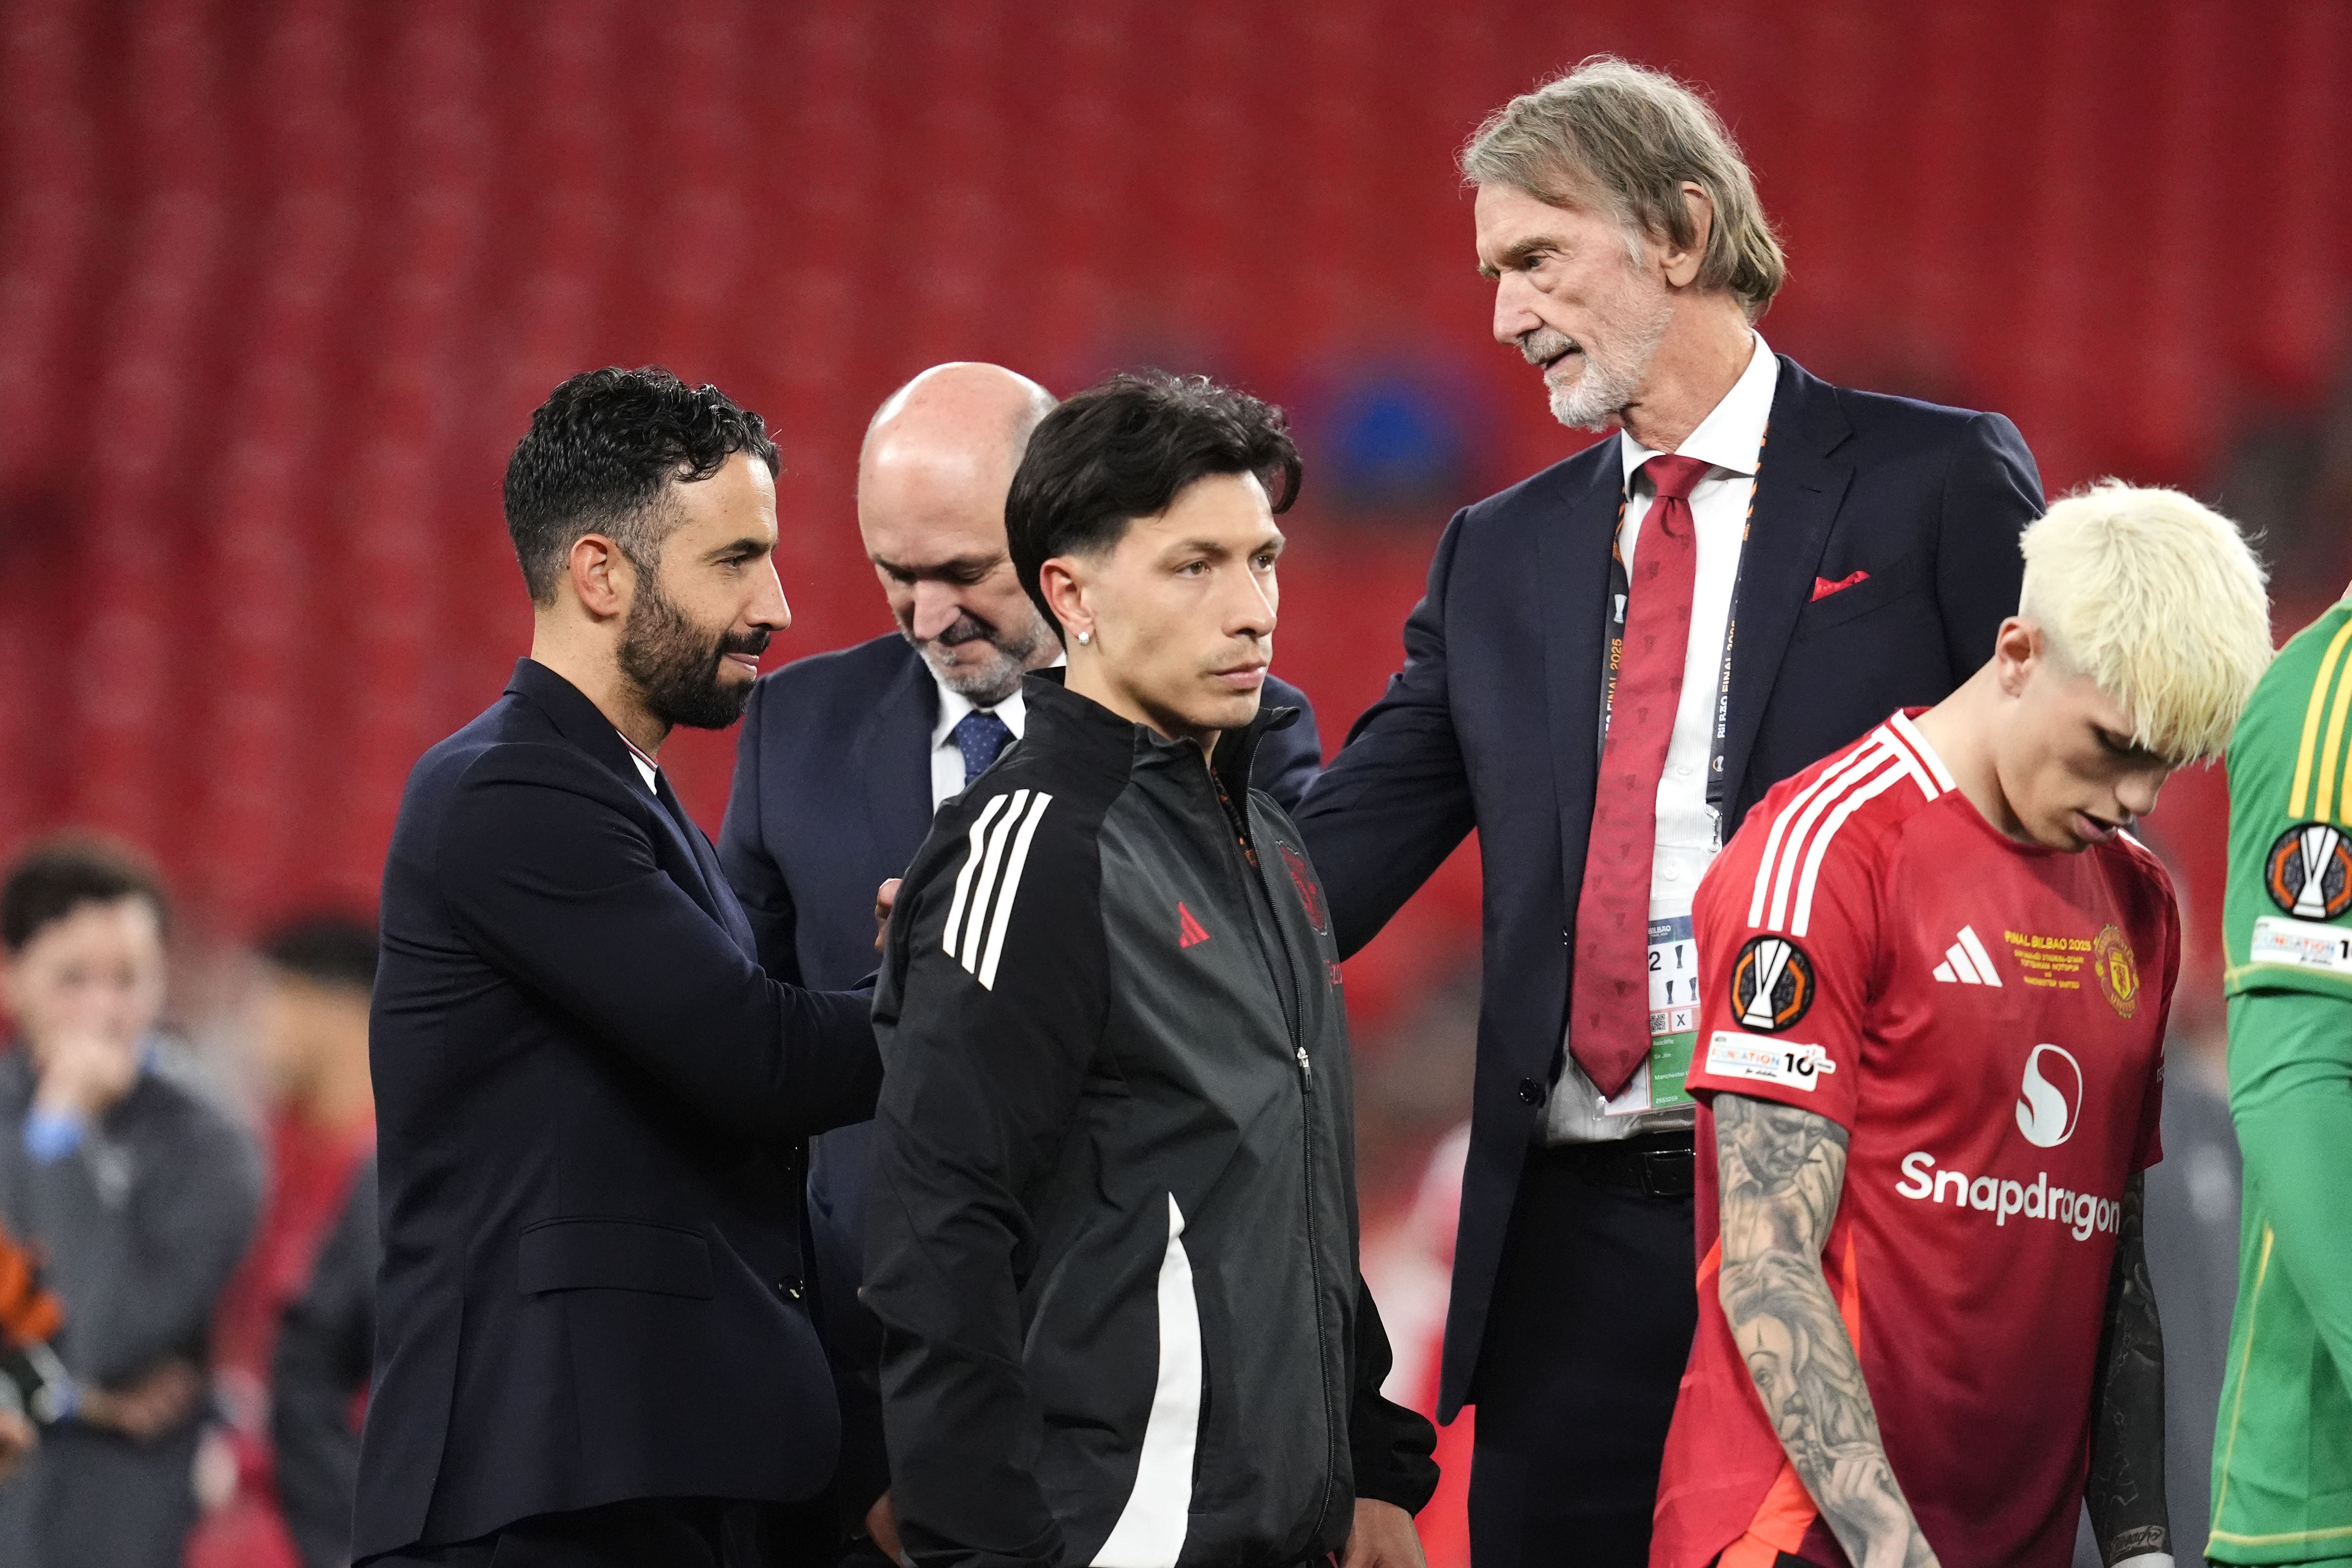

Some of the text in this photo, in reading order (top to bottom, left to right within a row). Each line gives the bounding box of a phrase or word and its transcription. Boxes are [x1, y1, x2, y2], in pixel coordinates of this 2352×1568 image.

[1610, 638, 1622, 670] 2025
[1722, 658, 1731, 692] FINAL
[1649, 925, 1671, 934] BILBAO
[2005, 930, 2092, 951] FINAL BILBAO 2025
[1676, 1014, 1686, 1026] X
[1895, 1151, 2120, 1242] Snapdragon
